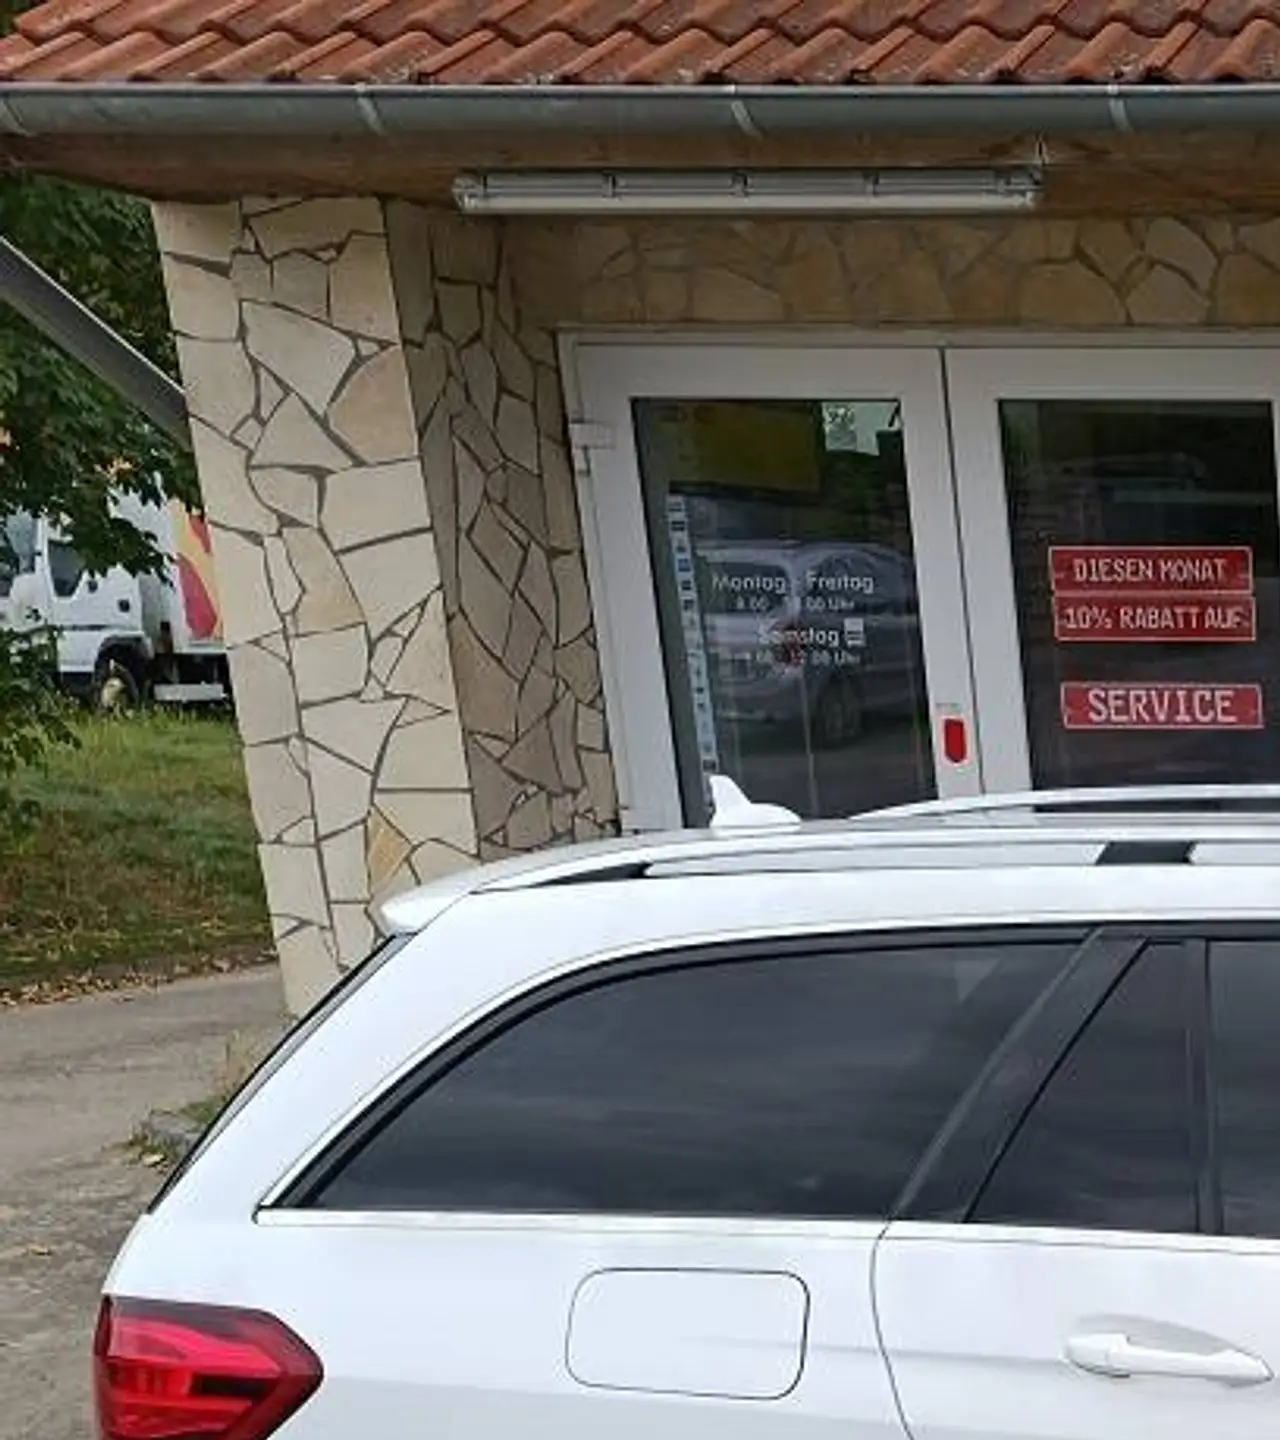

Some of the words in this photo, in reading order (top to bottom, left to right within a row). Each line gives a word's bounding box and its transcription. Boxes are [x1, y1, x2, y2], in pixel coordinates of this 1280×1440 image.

[712, 573, 787, 594] Montag
[806, 570, 874, 595] Freitag
[1073, 557, 1152, 583] DIESEN
[1160, 557, 1228, 583] MONAT
[1064, 606, 1112, 629] 10%
[1120, 605, 1202, 629] RABATT
[1087, 688, 1238, 724] SERVICE
